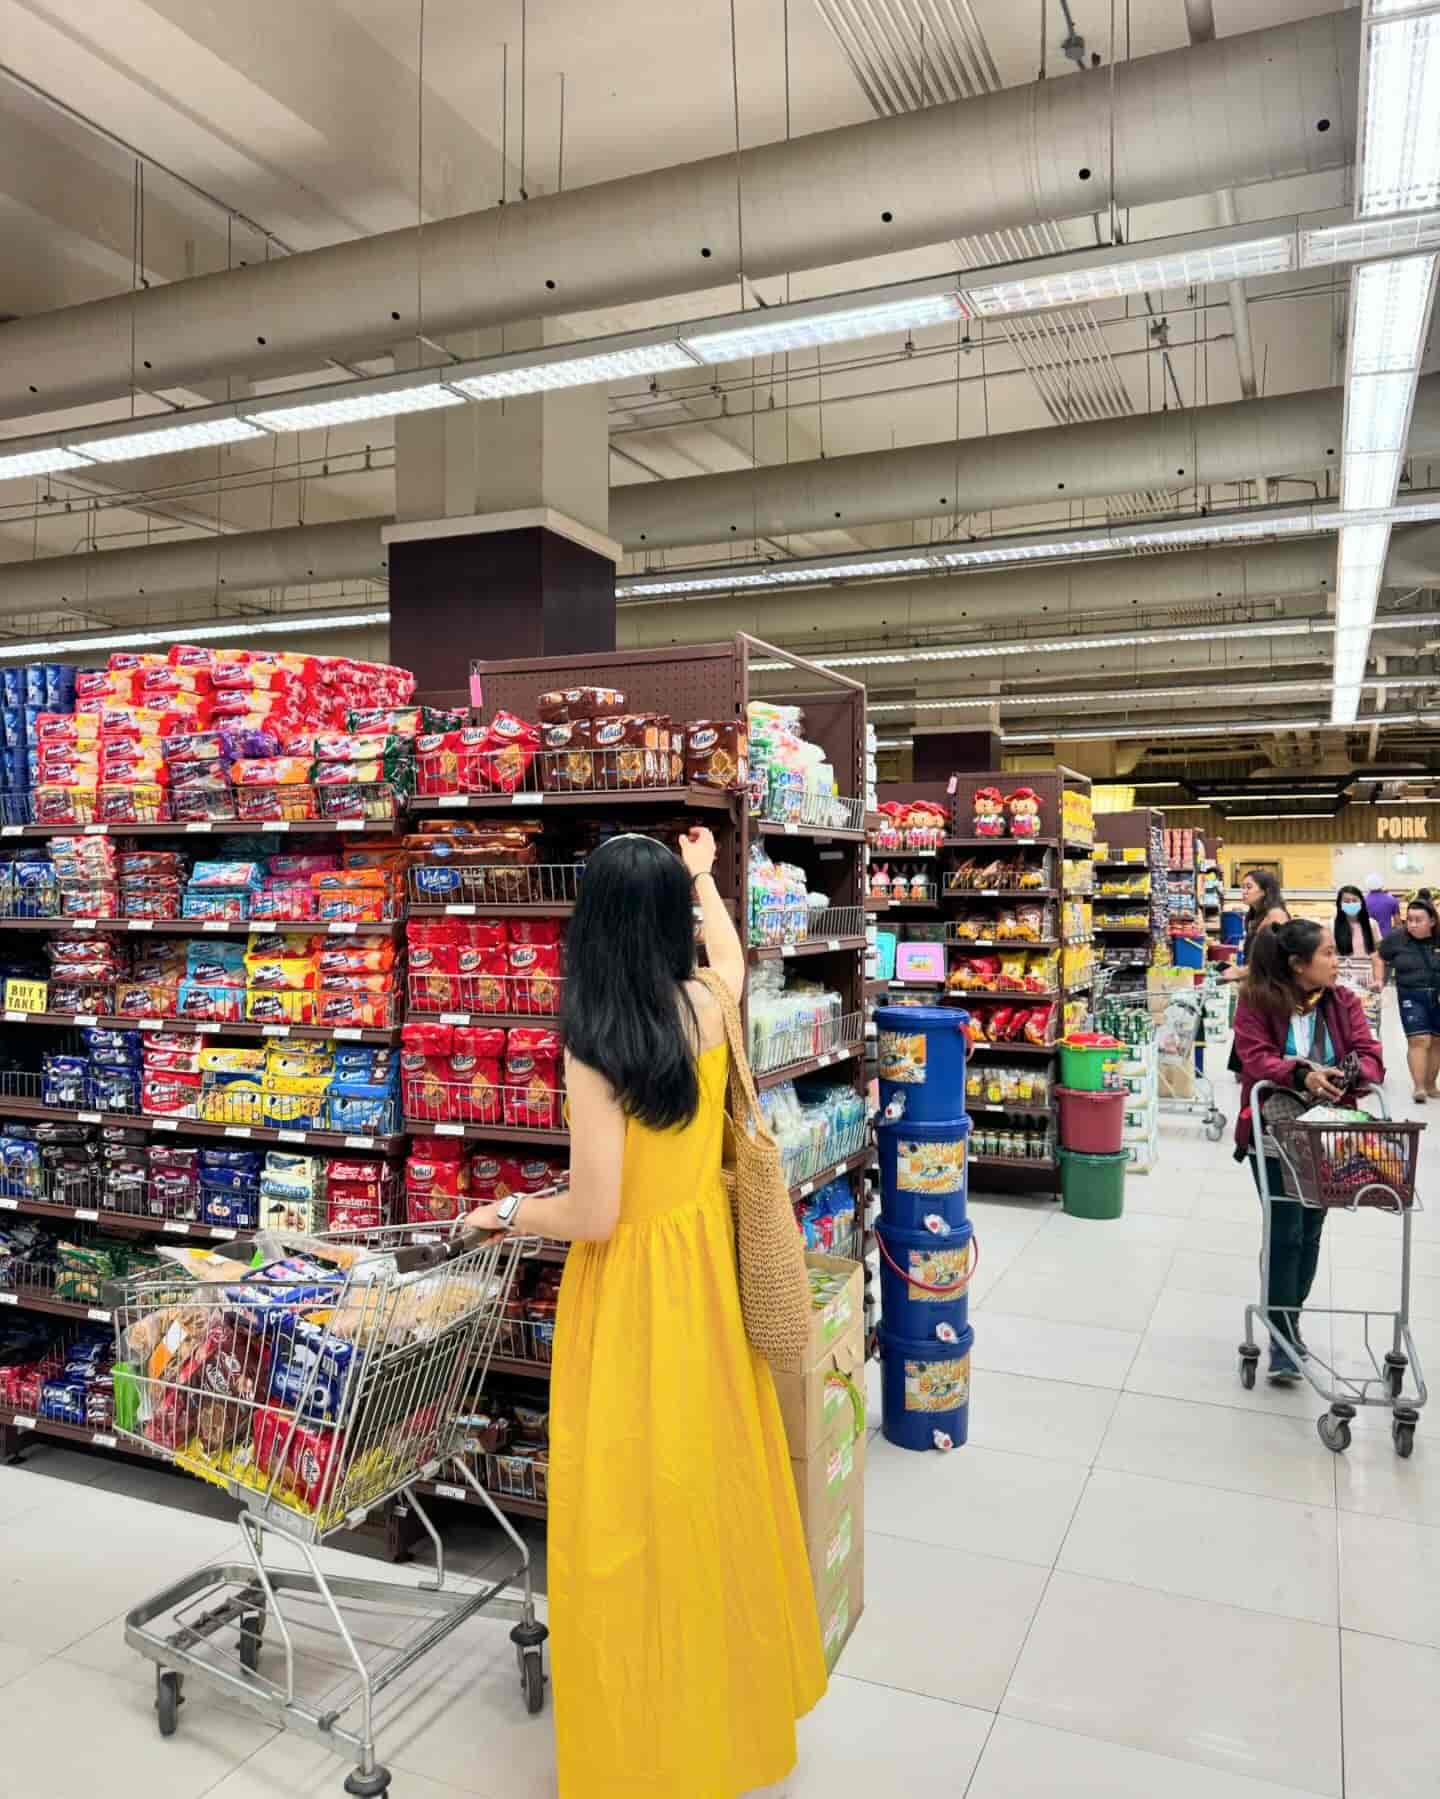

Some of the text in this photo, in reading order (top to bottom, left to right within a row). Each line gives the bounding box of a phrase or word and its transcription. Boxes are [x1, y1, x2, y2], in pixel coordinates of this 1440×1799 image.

[1377, 816, 1427, 839] PORK
[11, 984, 34, 998] BUY
[8, 996, 34, 1010] TAKE
